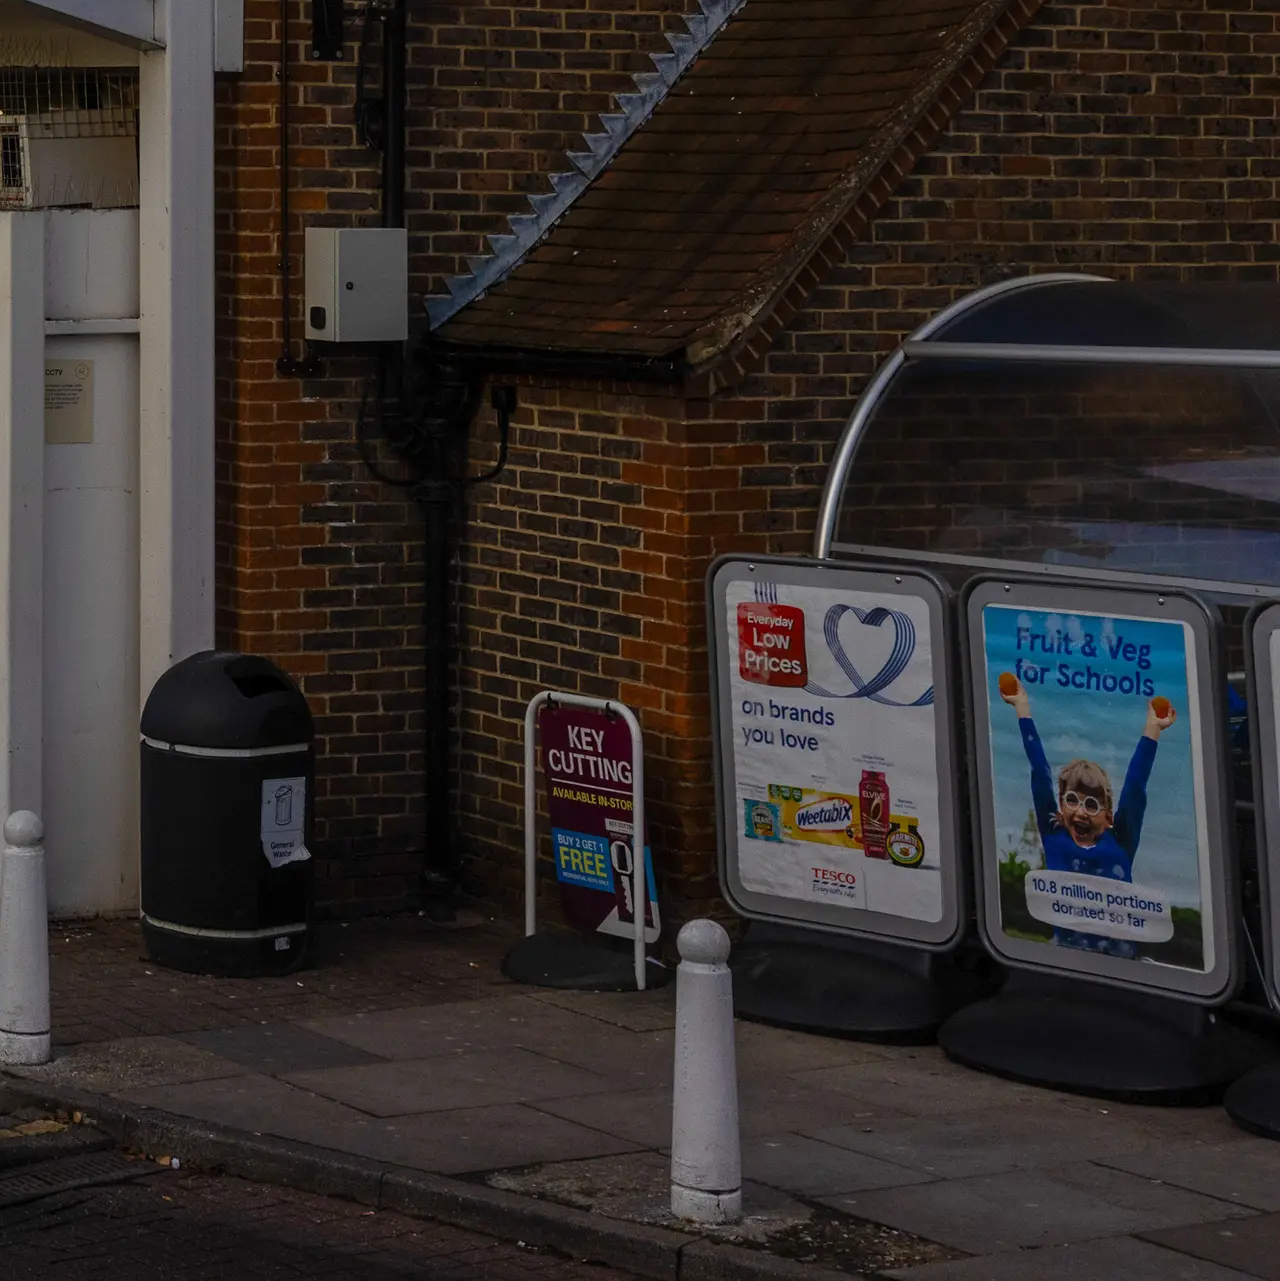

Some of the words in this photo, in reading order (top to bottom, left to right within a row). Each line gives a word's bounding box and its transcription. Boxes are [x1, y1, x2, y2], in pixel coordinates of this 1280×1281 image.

[747, 612, 794, 630] Everyday
[753, 628, 790, 650] Low
[1016, 626, 1073, 656] Fruit
[1080, 632, 1098, 658] &
[1103, 634, 1151, 670] Veg
[744, 650, 802, 675] Prices
[1015, 658, 1050, 685] for
[1056, 663, 1155, 697] Schools
[742, 699, 764, 717] on
[769, 699, 835, 726] brands
[567, 724, 605, 753] KEY
[742, 727, 775, 747] you
[779, 728, 819, 751] love
[548, 749, 633, 785] CUTTING
[553, 786, 597, 806] AVAILABLE
[598, 793, 633, 811] IN-STOR
[861, 790, 887, 801] ELVIVE
[618, 822, 634, 830] CUTTIN
[797, 803, 854, 826] Weetabix
[270, 841, 295, 851] General
[273, 850, 292, 859] Waste
[558, 834, 573, 846] BUY
[575, 837, 581, 848] 2
[581, 839, 597, 851] GET
[598, 843, 604, 853] 1
[559, 846, 608, 878] FREE
[811, 867, 856, 885] TESCO
[1032, 877, 1057, 894] 10.8
[1061, 884, 1103, 903] million
[1106, 893, 1164, 913] portions
[1052, 900, 1105, 920] donated
[1109, 913, 1125, 924] so
[1127, 913, 1147, 928] far
